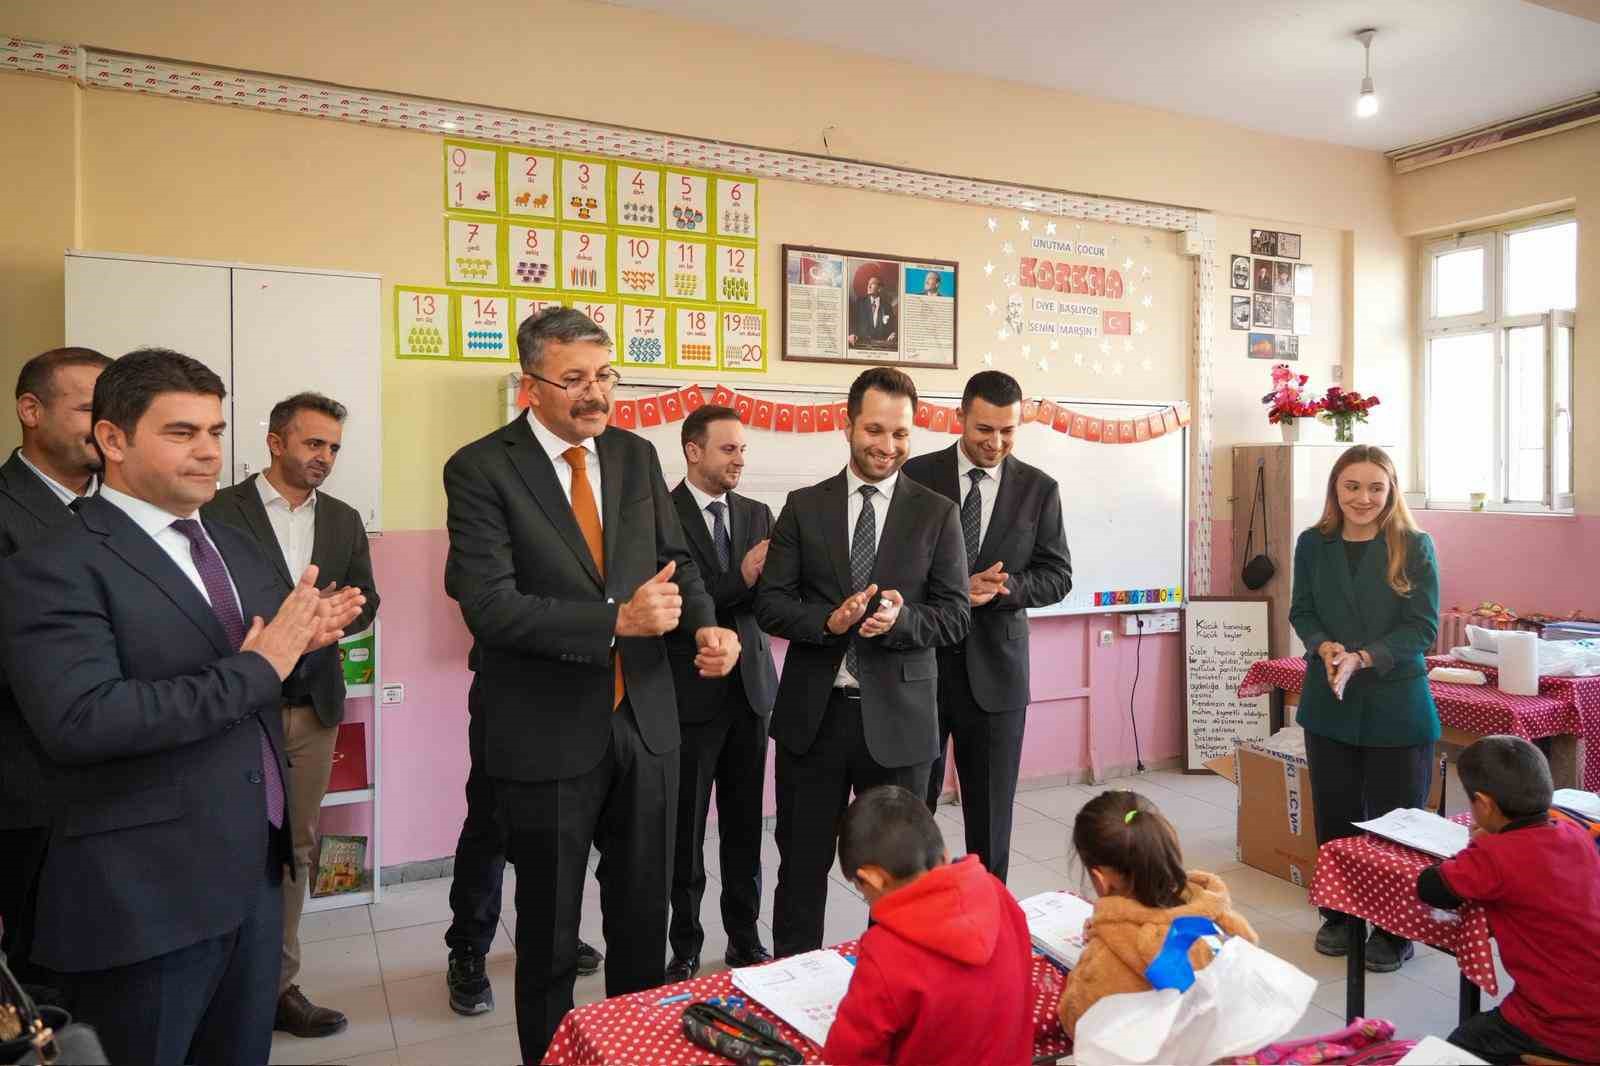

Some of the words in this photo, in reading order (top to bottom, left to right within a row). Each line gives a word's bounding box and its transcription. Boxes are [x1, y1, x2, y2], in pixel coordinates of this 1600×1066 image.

[452, 148, 466, 168] 0
[526, 156, 537, 176] 2
[578, 164, 590, 184] 3
[632, 172, 645, 189] 4
[455, 181, 463, 201] 1
[681, 176, 692, 195] 5
[730, 184, 742, 201] 6
[468, 224, 480, 243] 7
[526, 230, 538, 248] 8
[578, 234, 590, 252] 9
[628, 239, 650, 258] 10
[678, 244, 694, 264] 11
[1033, 239, 1071, 252] UNUTMA
[1077, 244, 1104, 256] ÇOCUK
[727, 248, 745, 268] 12
[1020, 256, 1124, 300] KORKMA
[412, 295, 436, 316] 13
[474, 298, 497, 318] 14
[585, 304, 605, 324] 16
[1060, 304, 1098, 316] BAŞLIYOR
[635, 308, 656, 328] 17
[688, 312, 706, 330] 18
[724, 314, 741, 332] 19
[742, 344, 762, 362] 20
